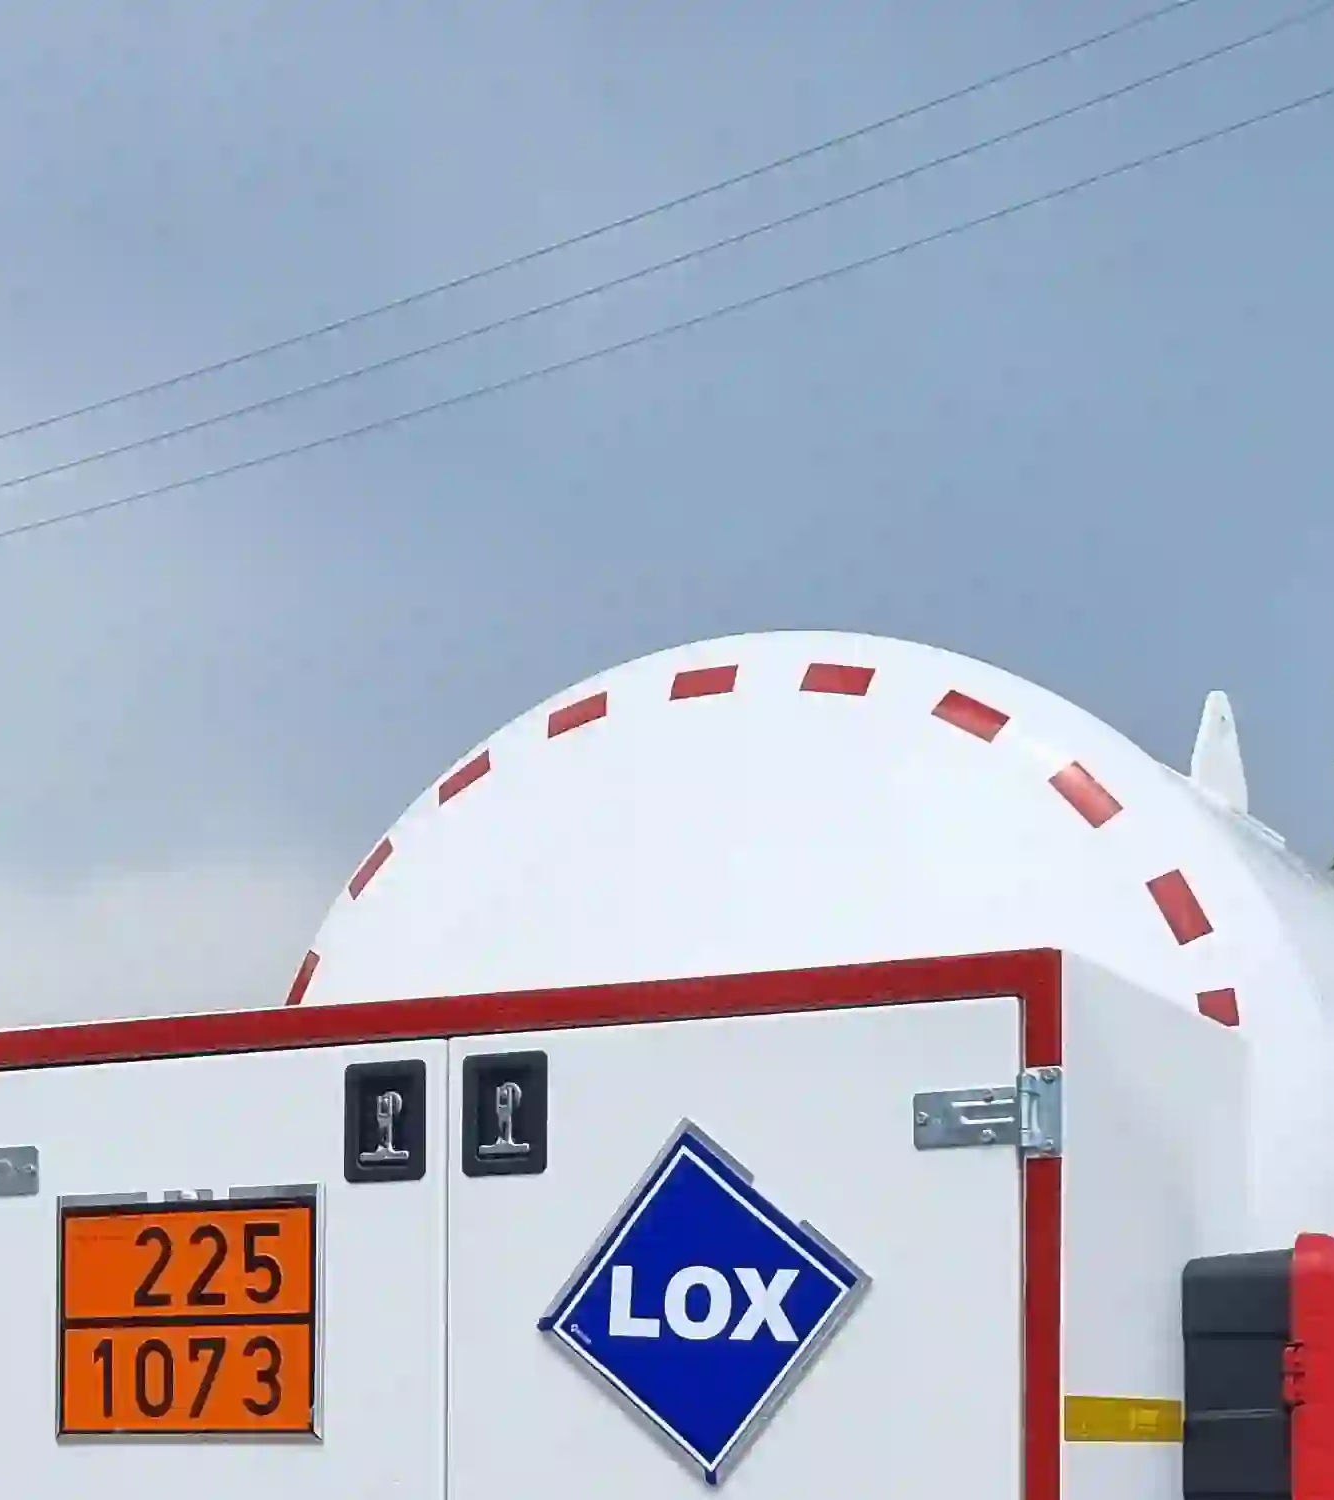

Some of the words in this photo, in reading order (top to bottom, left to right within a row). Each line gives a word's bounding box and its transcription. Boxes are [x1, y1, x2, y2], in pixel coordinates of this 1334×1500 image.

[133, 1222, 283, 1308] 225
[608, 1264, 800, 1342] LOX
[93, 1336, 283, 1419] 1073
